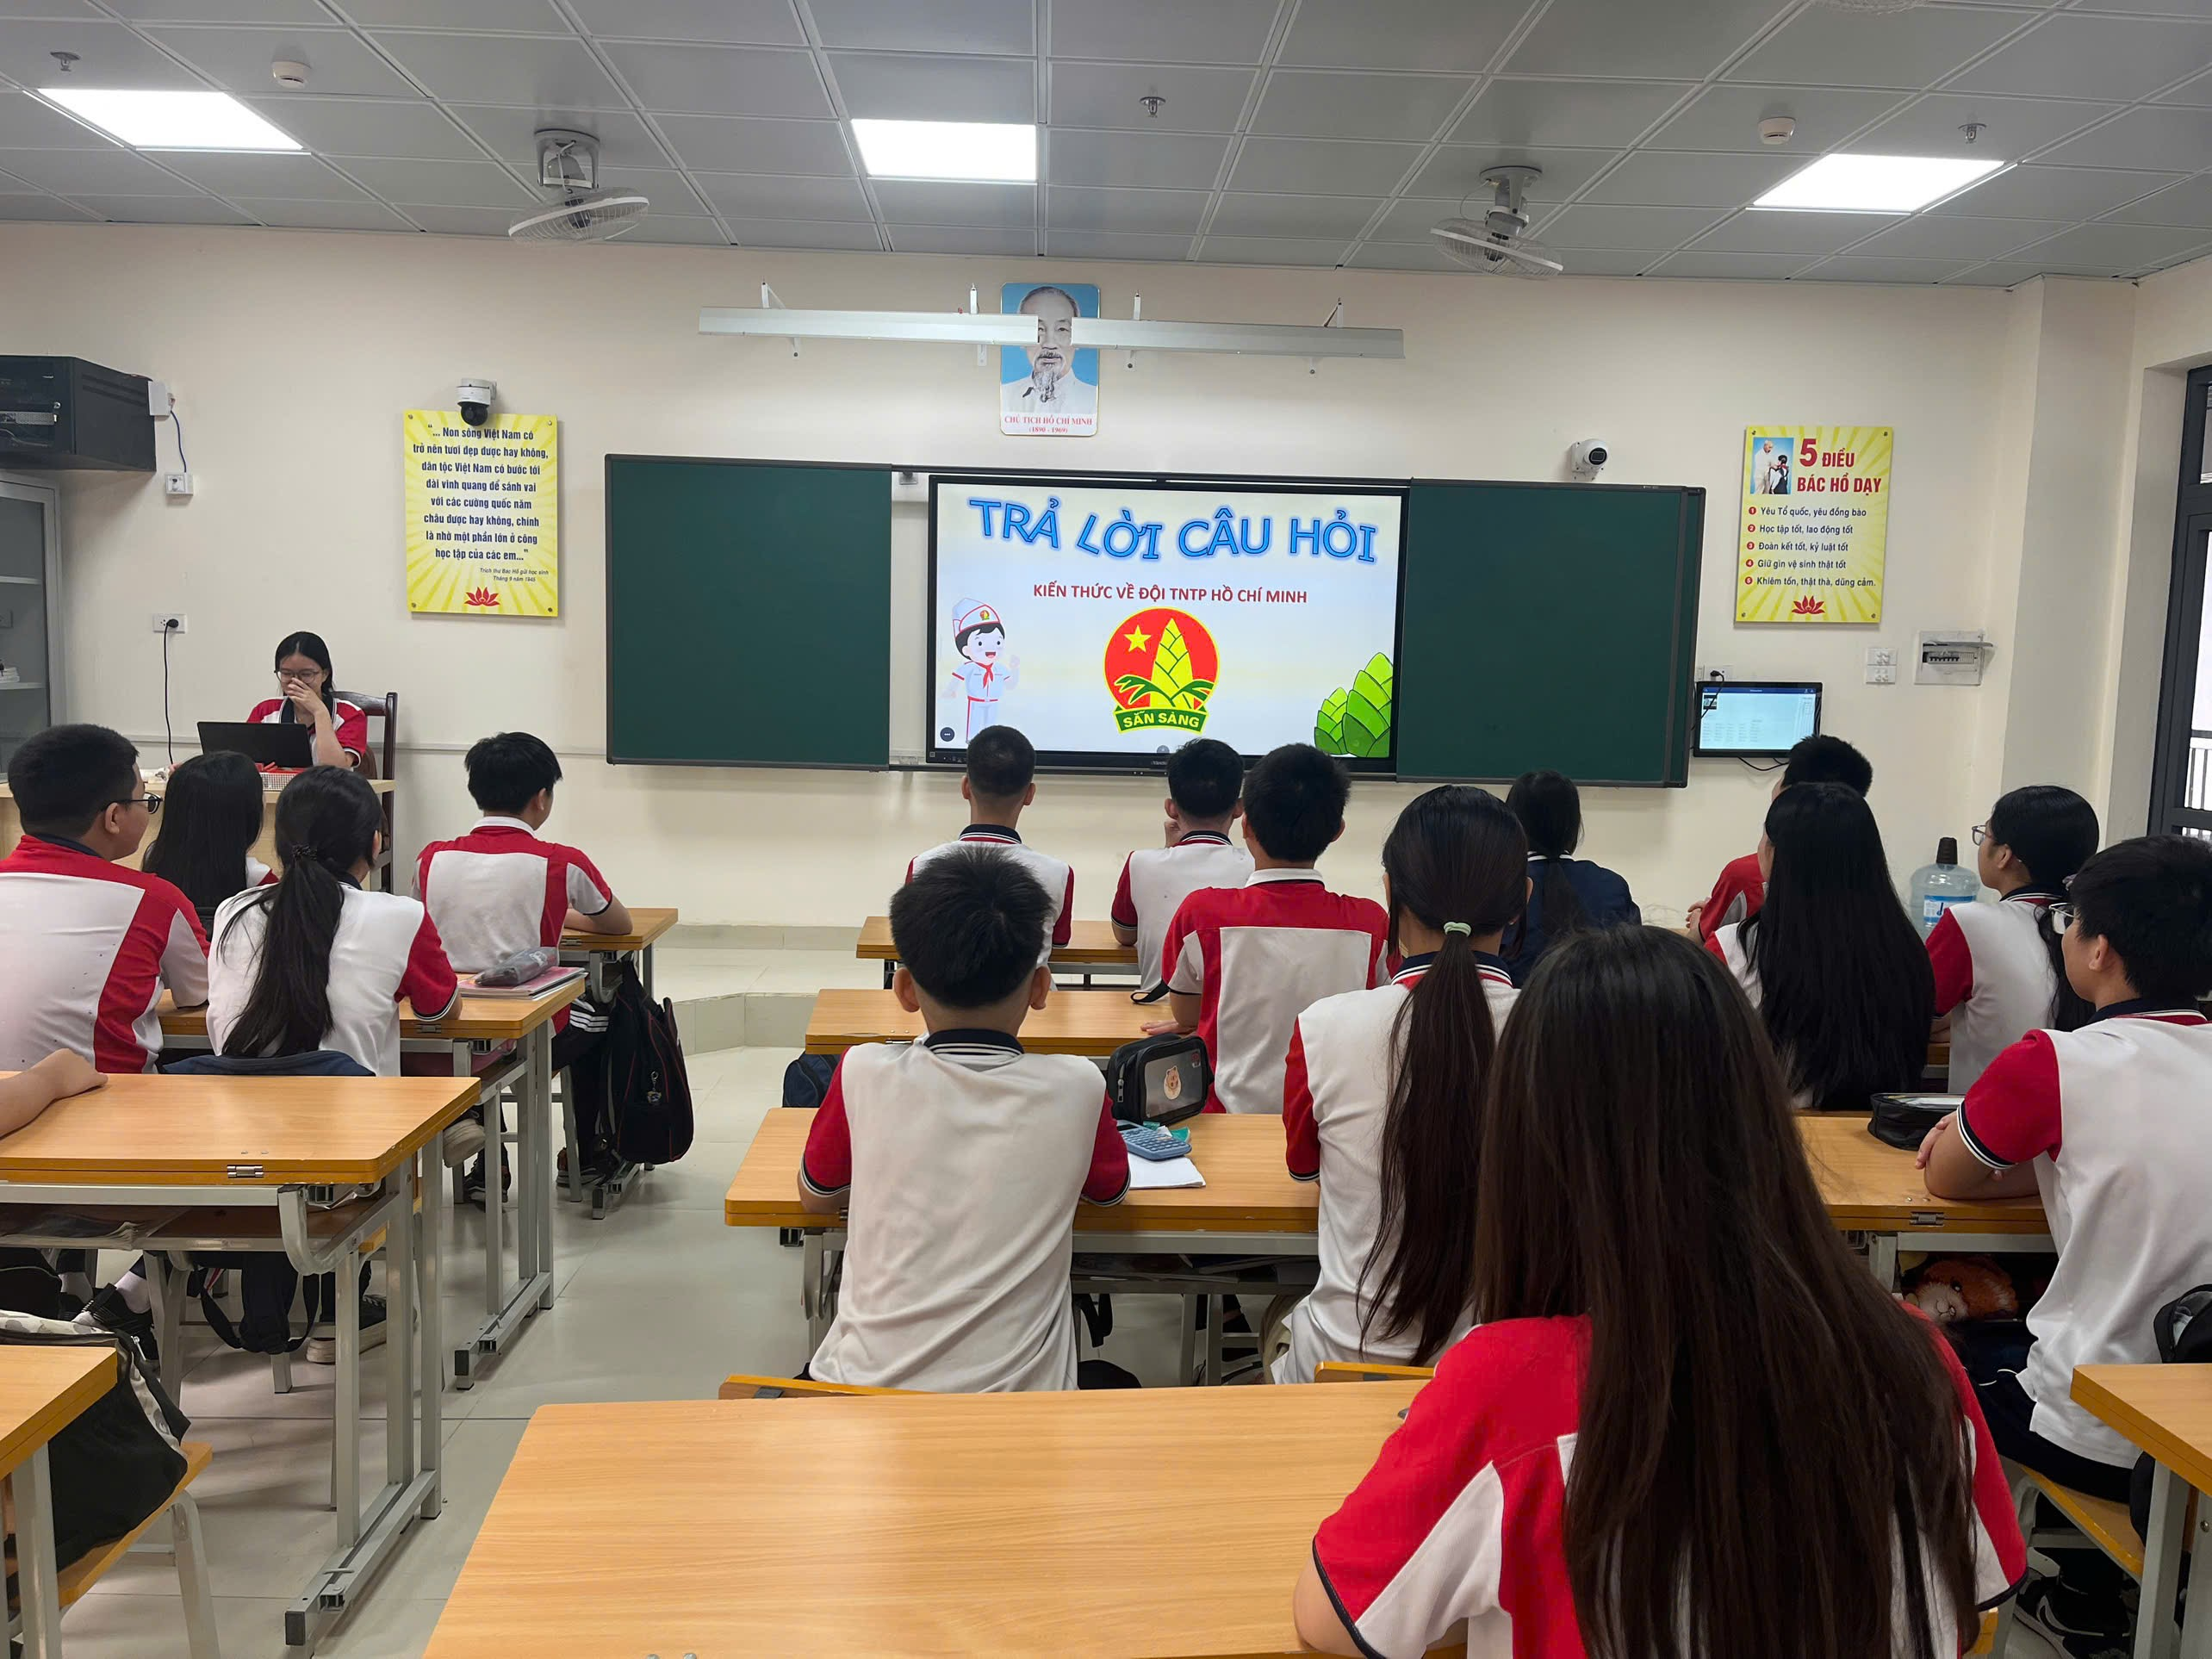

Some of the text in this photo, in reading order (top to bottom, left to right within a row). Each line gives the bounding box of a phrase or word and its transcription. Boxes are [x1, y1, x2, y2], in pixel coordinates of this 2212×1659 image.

[1056, 416, 1070, 425] CHÍ
[443, 427, 459, 438] Non
[462, 428, 482, 438] sông
[483, 429, 500, 440] Việt
[501, 430, 521, 439] Nam
[524, 431, 533, 440] có
[413, 443, 549, 459] trở nên tươi đẹp được hay không,
[1799, 438, 1855, 467] 5 ĐIỀU
[422, 462, 540, 475] dân tộc Việt Nam có bước tới
[426, 479, 536, 492] đài vinh quang để sánh vai
[1797, 472, 1882, 496] BÁC HỒ DẠY
[431, 497, 531, 509] với các cường quốc năm
[1778, 505, 1788, 515] Tổ
[1790, 506, 1811, 517] quốc,
[1813, 508, 1827, 518] yêu
[1829, 507, 1849, 518] đồng
[424, 513, 539, 527] châu được hay không, chính
[968, 497, 1377, 563] TRẢ LỜI CÂU HỎI
[1760, 525, 1774, 534] Học
[1777, 525, 1789, 535] tập
[1792, 524, 1804, 534] tốt,
[1820, 525, 1840, 535] động
[1842, 525, 1853, 534] tốt
[426, 531, 537, 545] là nhờ một phần lớn ở công
[1759, 542, 1779, 550] Đoàn
[1781, 541, 1793, 550] kết
[1795, 542, 1808, 552] tốt,
[1810, 542, 1819, 553] kỷ
[1821, 543, 1836, 552] luật
[1837, 542, 1849, 551] tốt
[435, 549, 450, 560] học
[453, 549, 466, 561] tập
[469, 549, 484, 559] của
[486, 550, 501, 560] các
[1757, 559, 1772, 568] Giữ
[1774, 560, 1786, 569] gìn
[1787, 560, 1797, 569] vệ
[1799, 560, 1816, 569] sinh
[1818, 560, 1833, 569] thật
[1836, 559, 1846, 569] tốt
[1784, 576, 1799, 586] tốn,
[1801, 577, 1816, 587] thật
[1818, 577, 1833, 587] thà,
[1835, 577, 1855, 587] dũng
[1857, 577, 1876, 587] cảm.
[1034, 581, 1308, 604] KIẾN THỨC VỀ ĐỘI TNTP HỒ CHÍ MINH
[1122, 711, 1200, 728] SẴN SÀNG
